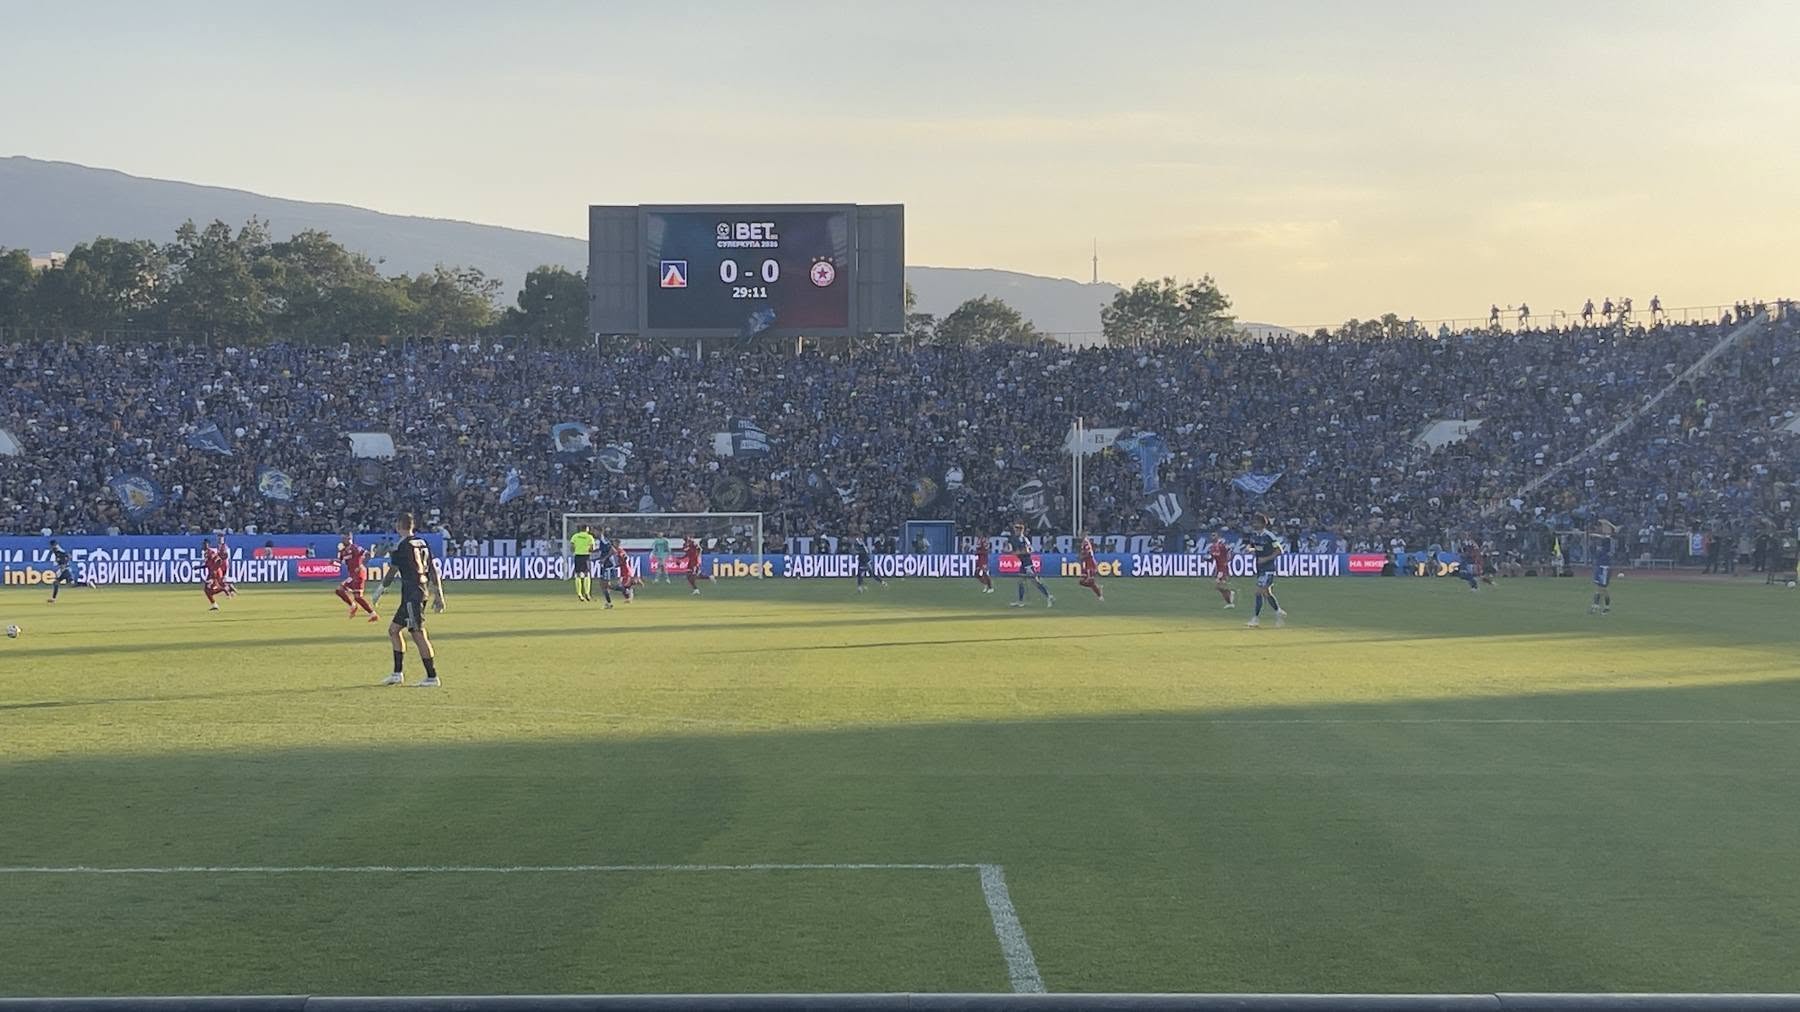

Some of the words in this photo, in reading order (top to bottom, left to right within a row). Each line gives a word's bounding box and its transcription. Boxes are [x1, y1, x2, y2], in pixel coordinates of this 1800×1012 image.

[720, 259, 738, 283] 0
[762, 259, 780, 283] 0
[732, 287, 767, 298] 29:11
[4, 565, 67, 584] inbe
[77, 561, 167, 583] ЗАВИШЕНИ
[713, 558, 773, 577] inbet
[784, 554, 868, 577] ЗАВИШЕН
[874, 554, 980, 577] КОЕФИЦИЕНТ
[1061, 557, 1122, 577] inet
